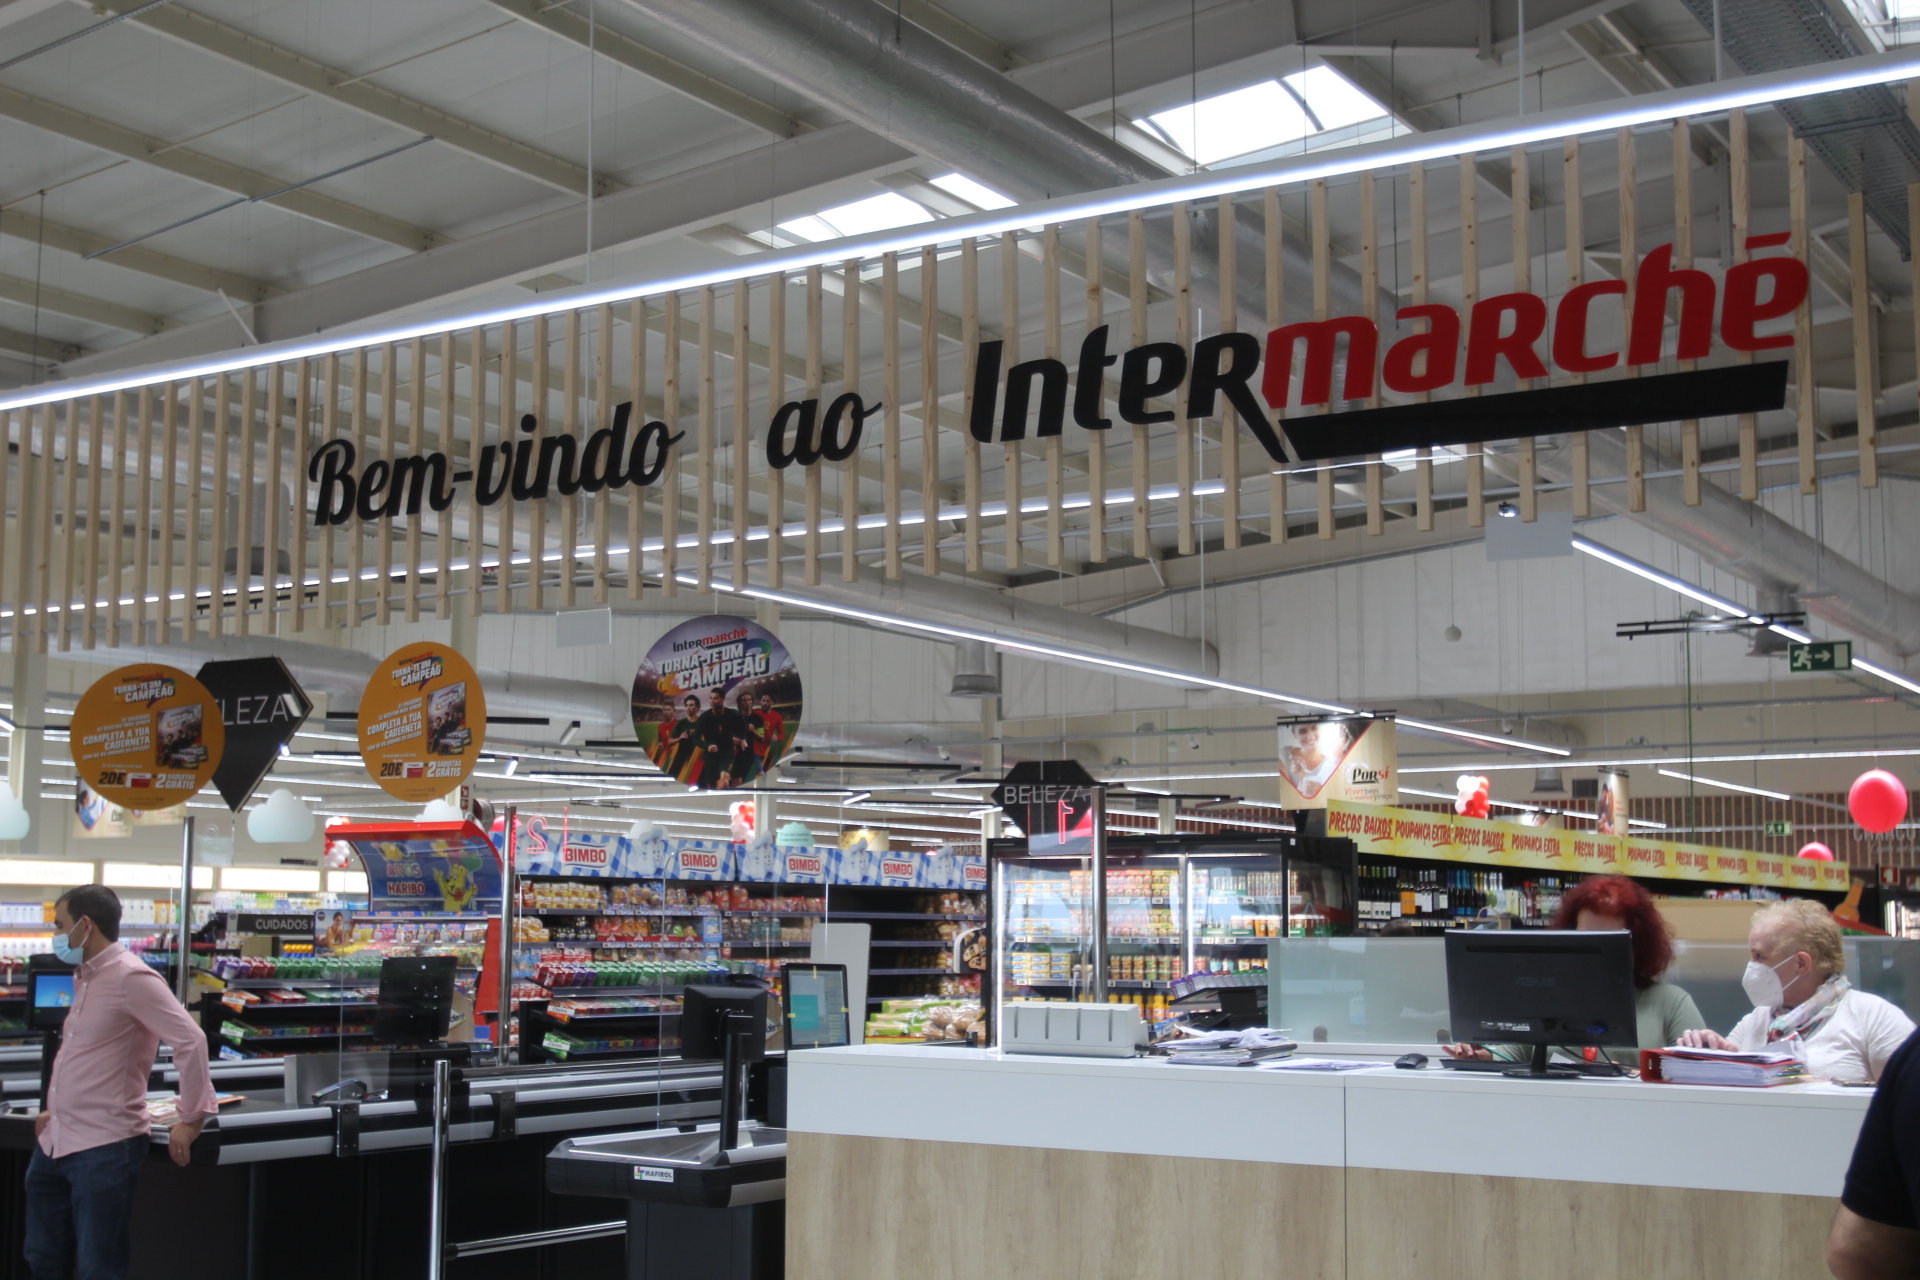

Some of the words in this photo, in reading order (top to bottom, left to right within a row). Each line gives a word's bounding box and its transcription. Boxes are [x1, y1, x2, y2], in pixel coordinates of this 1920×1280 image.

[309, 401, 685, 526] Bem-vindo
[766, 391, 882, 469] ao
[969, 231, 1808, 463] Intermarché
[672, 627, 748, 653] Intermarché
[420, 659, 432, 670] UM
[657, 650, 722, 675] TORNA-TE
[722, 643, 744, 661] UM
[401, 664, 442, 687] CAMPEÃO
[678, 652, 768, 690] CAMPEÃO
[125, 686, 174, 703] CAMPEÃO
[216, 695, 288, 726] LEZA
[367, 717, 401, 736] COMPLETA
[402, 715, 408, 726] A
[409, 711, 422, 723] TUA
[384, 721, 422, 740] CADERNETA
[83, 730, 125, 746] COMPLETA
[127, 728, 133, 739] A
[135, 726, 150, 737] TUA
[104, 736, 150, 751] CADERNETA
[380, 762, 403, 777] 20€
[427, 761, 437, 778] 2
[436, 766, 461, 778] GRÁTIS
[98, 771, 127, 785] 20€
[155, 773, 167, 789] 2
[1004, 785, 1087, 804] BELEZA
[1364, 815, 1393, 838] BAIXOS
[1432, 824, 1451, 843] EXTRA
[564, 847, 607, 863] BIMBO
[681, 853, 718, 868] BIMBO
[789, 858, 821, 872] BIMBO
[883, 863, 913, 876] BIMBO
[965, 867, 986, 879] BIMB
[387, 881, 426, 896] HARIBO
[255, 919, 308, 930] CUIDADOS
[645, 1170, 673, 1179] MAFIROL
